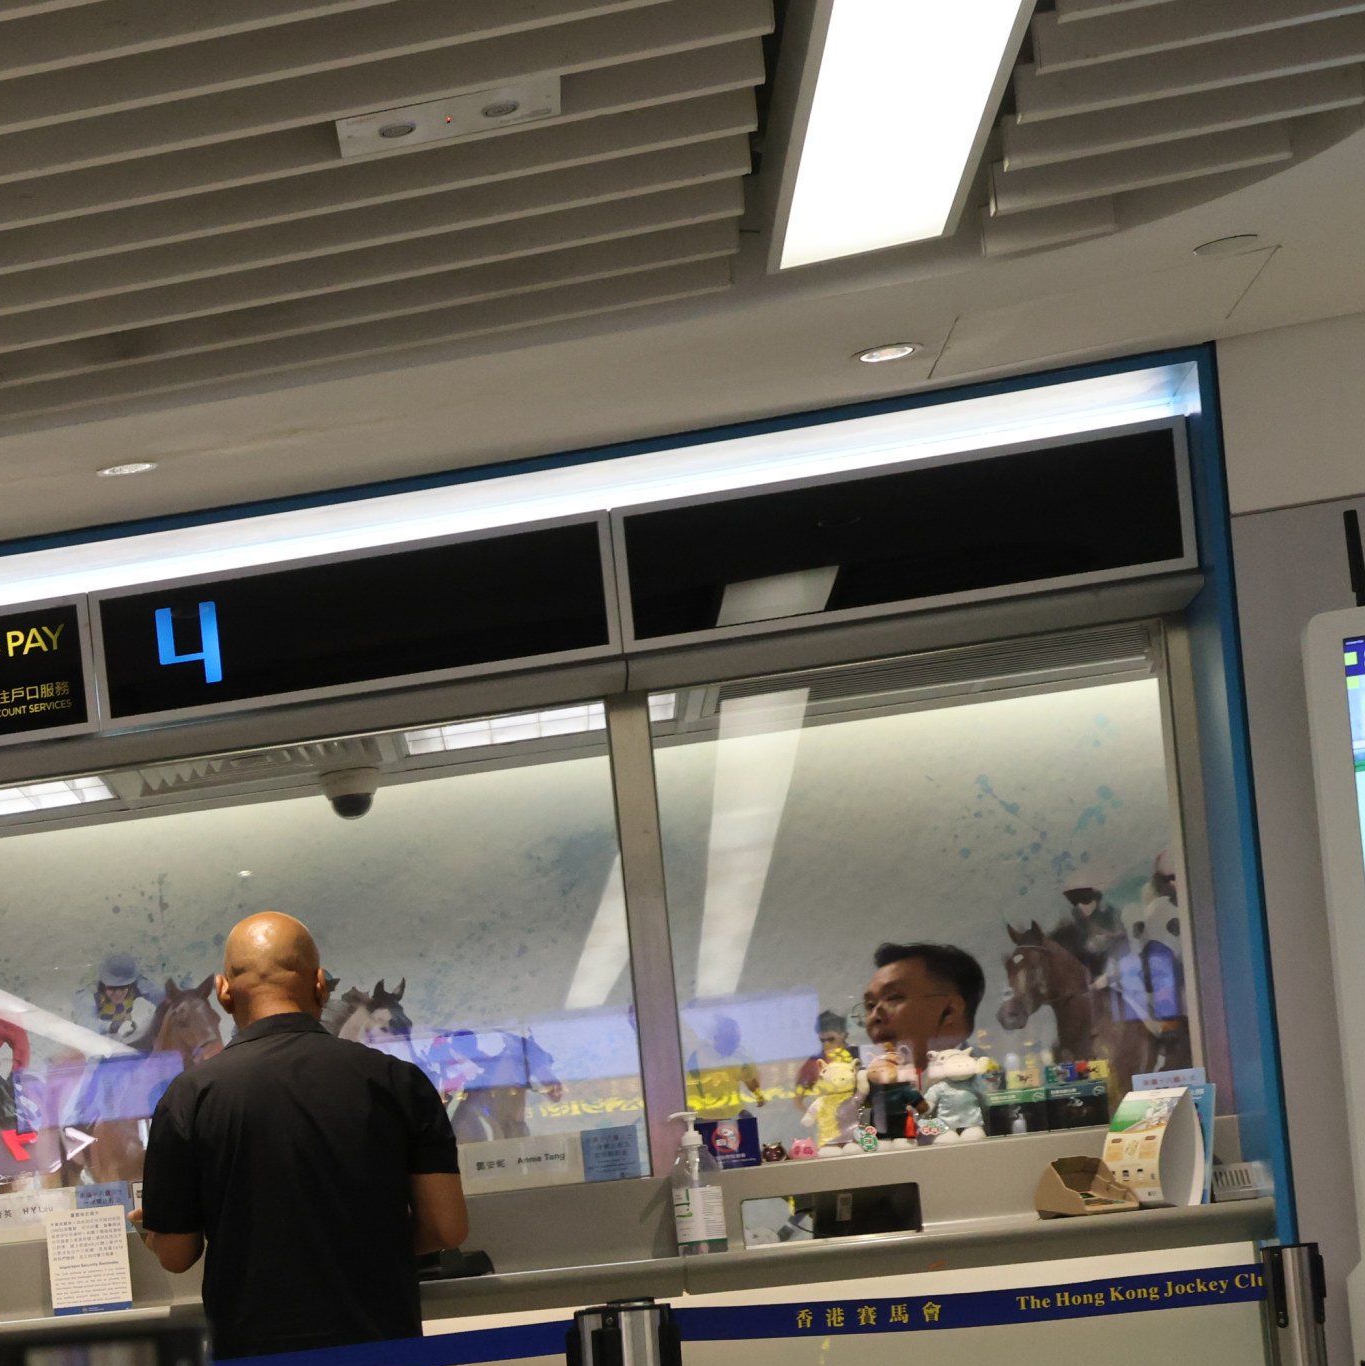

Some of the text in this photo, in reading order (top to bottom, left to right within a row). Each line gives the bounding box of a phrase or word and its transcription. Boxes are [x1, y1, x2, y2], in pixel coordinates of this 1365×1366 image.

[6, 623, 66, 657] PAY
[154, 601, 223, 684] 4
[29, 698, 73, 713] SERVICES
[1016, 1294, 1051, 1311] The
[1055, 1291, 1105, 1307] Hong
[1110, 1285, 1160, 1301] Kong
[1164, 1277, 1229, 1298] Jockey
[796, 1300, 942, 1329] 香港賽馬會
